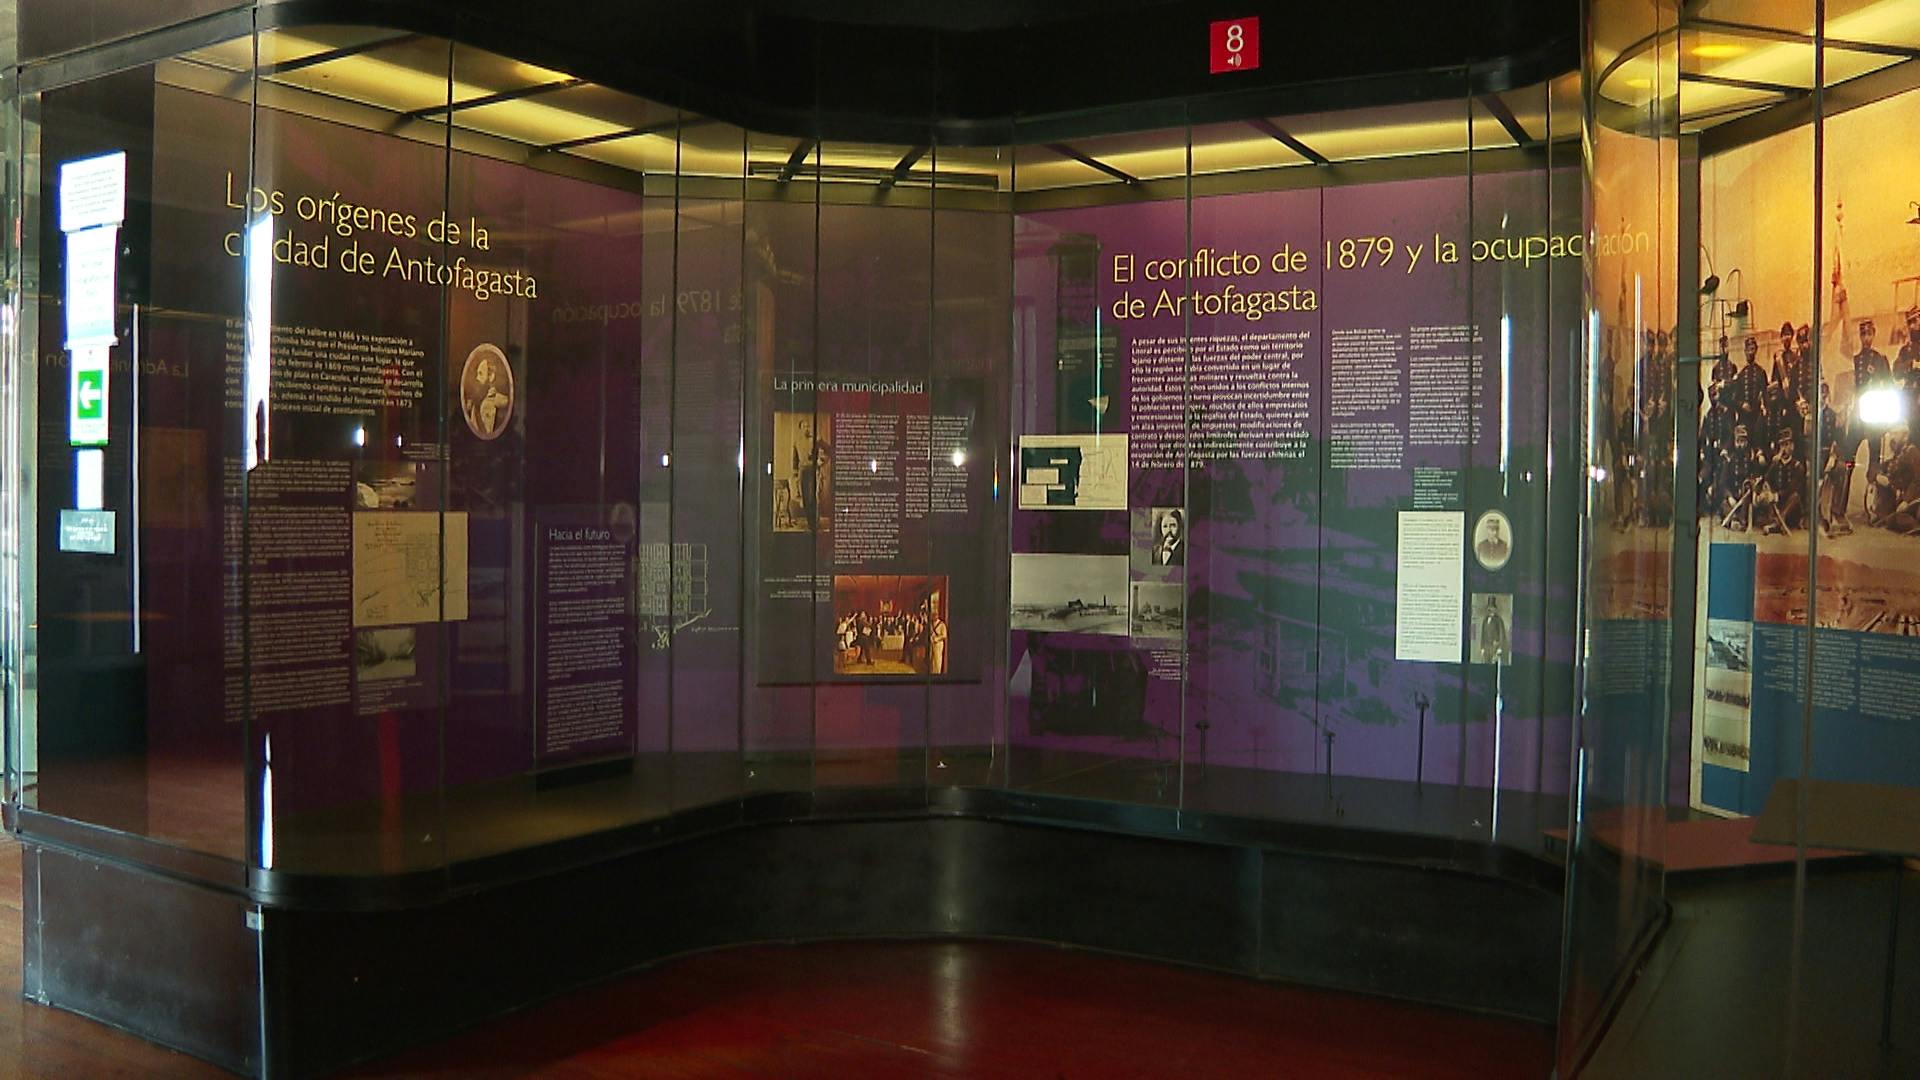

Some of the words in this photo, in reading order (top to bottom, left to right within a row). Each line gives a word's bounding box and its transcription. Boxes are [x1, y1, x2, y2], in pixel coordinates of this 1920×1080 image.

[1226, 25, 1244, 52] 8
[226, 170, 285, 215] Los
[296, 191, 417, 238] orígenes
[427, 210, 461, 244] de
[470, 216, 490, 250] la
[224, 225, 328, 269] cidad
[340, 240, 375, 275] de
[382, 246, 538, 301] Antofagasta
[1114, 253, 1135, 283] El
[1145, 248, 1261, 281] conflicto
[1271, 243, 1308, 273] de
[1326, 236, 1395, 271] 1879
[1406, 243, 1425, 274] y
[1434, 232, 1459, 265] la
[1471, 234, 1583, 269] ocupac
[1112, 290, 1146, 319] de
[1216, 344, 1239, 352] Estado
[1250, 332, 1298, 342] departamento
[773, 377, 787, 391] La
[842, 379, 924, 396] municipalidad
[549, 528, 573, 540] Hacia
[575, 527, 583, 540] el
[585, 528, 610, 540] futuro
